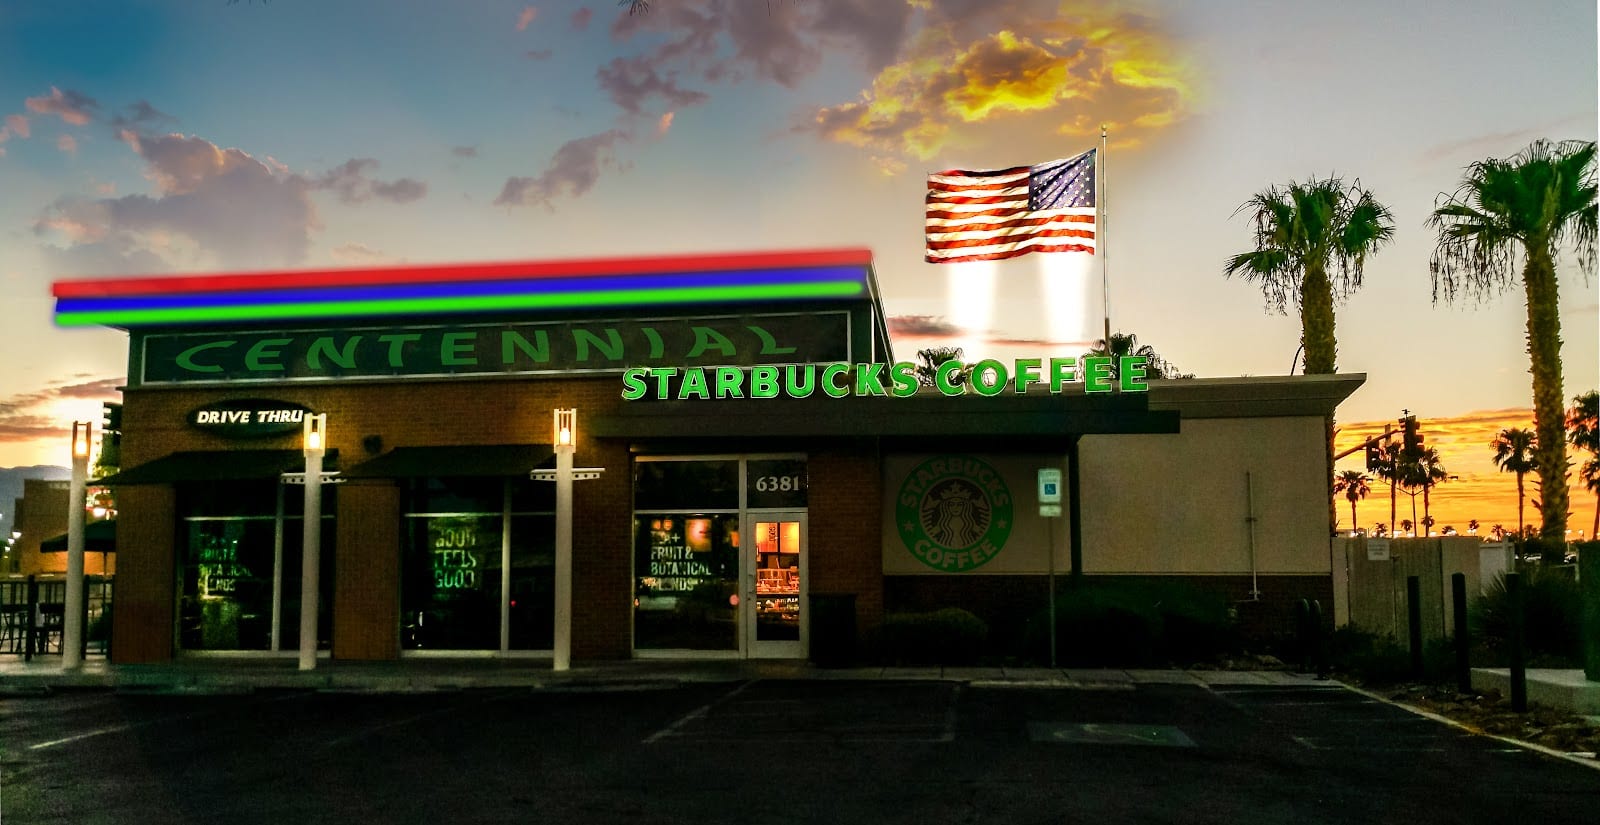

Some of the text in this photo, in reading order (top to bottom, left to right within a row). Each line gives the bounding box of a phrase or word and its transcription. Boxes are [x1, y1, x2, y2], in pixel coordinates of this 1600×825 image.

[175, 325, 798, 373] CENTENNIAL
[620, 356, 1150, 401] STARBUCKS COFFEE
[196, 409, 304, 424] DRIVE THRU
[755, 475, 800, 492] 6381
[901, 457, 1009, 509] STARBUCKS
[650, 546, 684, 560] FRUIT
[914, 538, 998, 569] COFFEE
